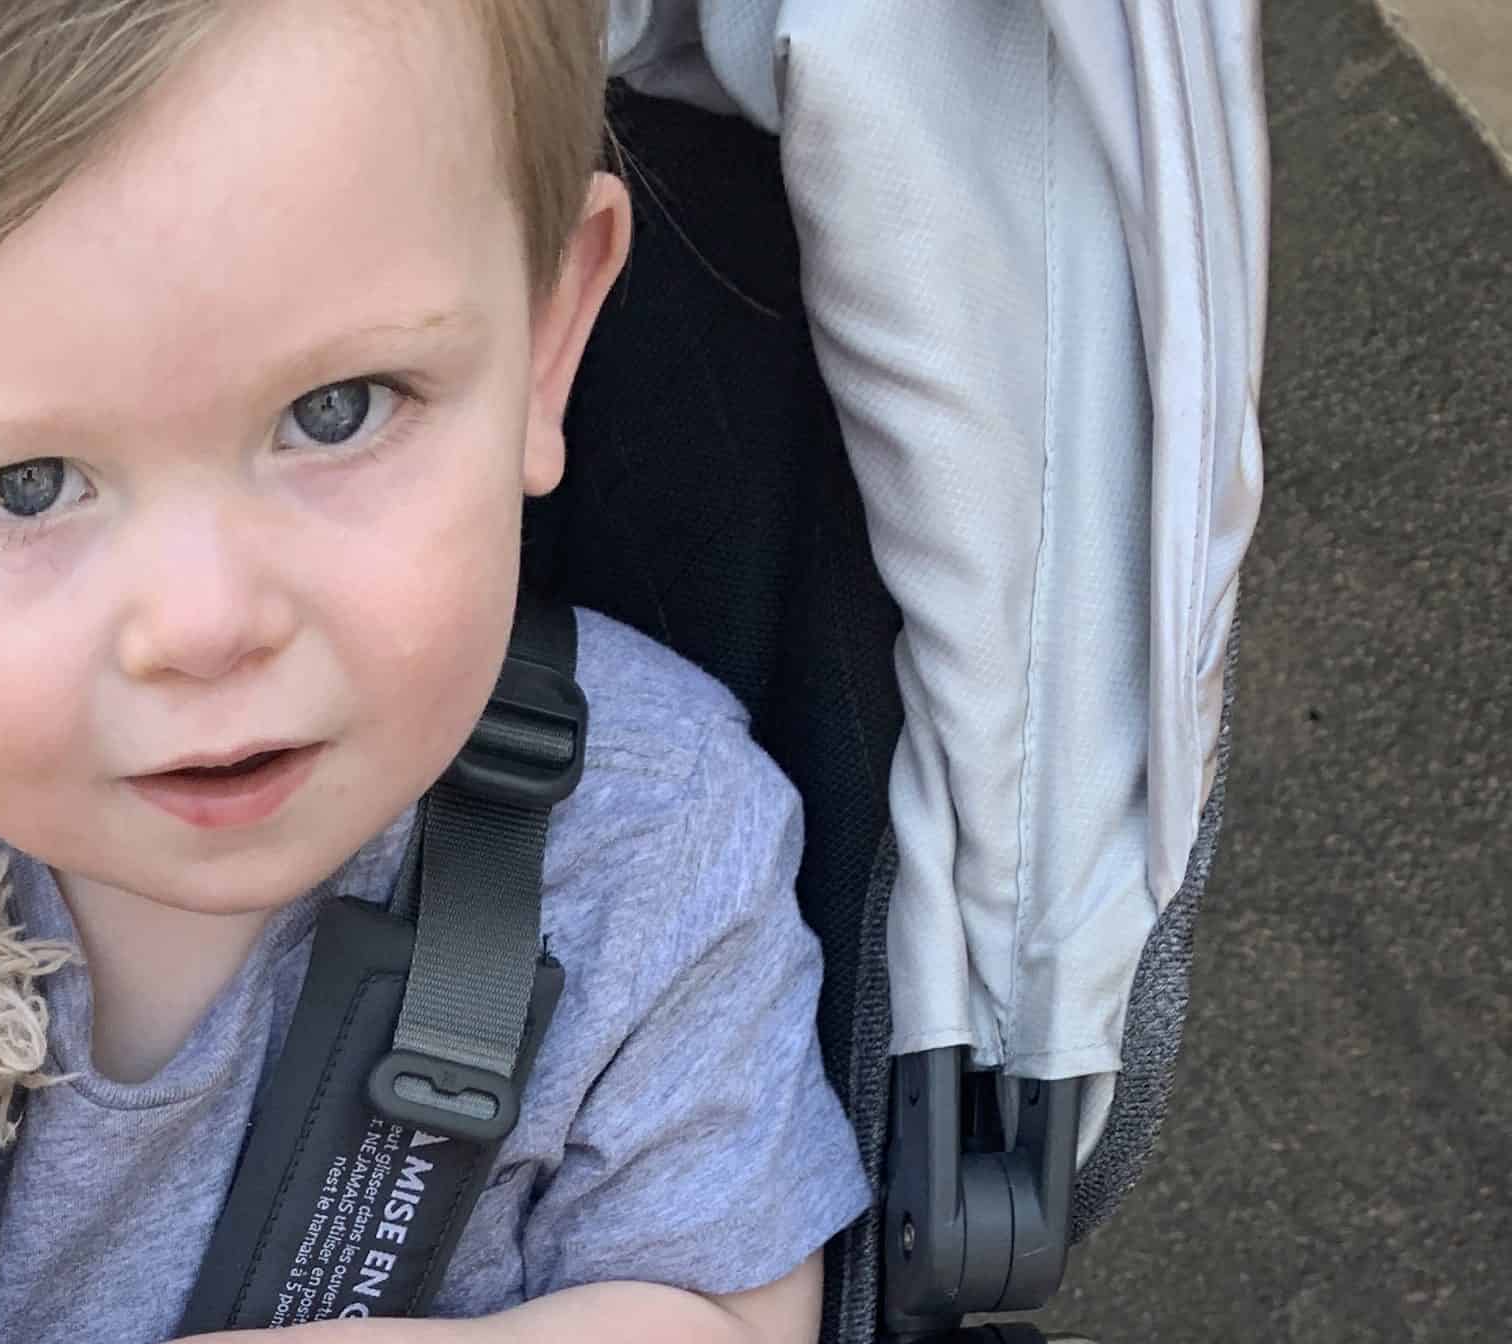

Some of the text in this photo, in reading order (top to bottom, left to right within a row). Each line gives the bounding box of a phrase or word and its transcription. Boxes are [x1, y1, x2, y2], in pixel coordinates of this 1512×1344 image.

[359, 1131, 382, 1155] NE
[383, 1124, 403, 1152] eut
[337, 1150, 372, 1215] JAMAIS
[363, 1152, 392, 1204] glisser
[316, 1195, 336, 1211] le
[375, 1155, 434, 1245] MISE
[294, 1212, 329, 1265] harnais
[317, 1215, 347, 1265] utiliser
[348, 1205, 374, 1243] dans
[289, 1267, 308, 1278] à
[338, 1243, 361, 1264] les
[285, 1280, 303, 1293] 5
[308, 1267, 325, 1287] en
[352, 1249, 397, 1297] EN
[313, 1264, 347, 1322] ouvertu
